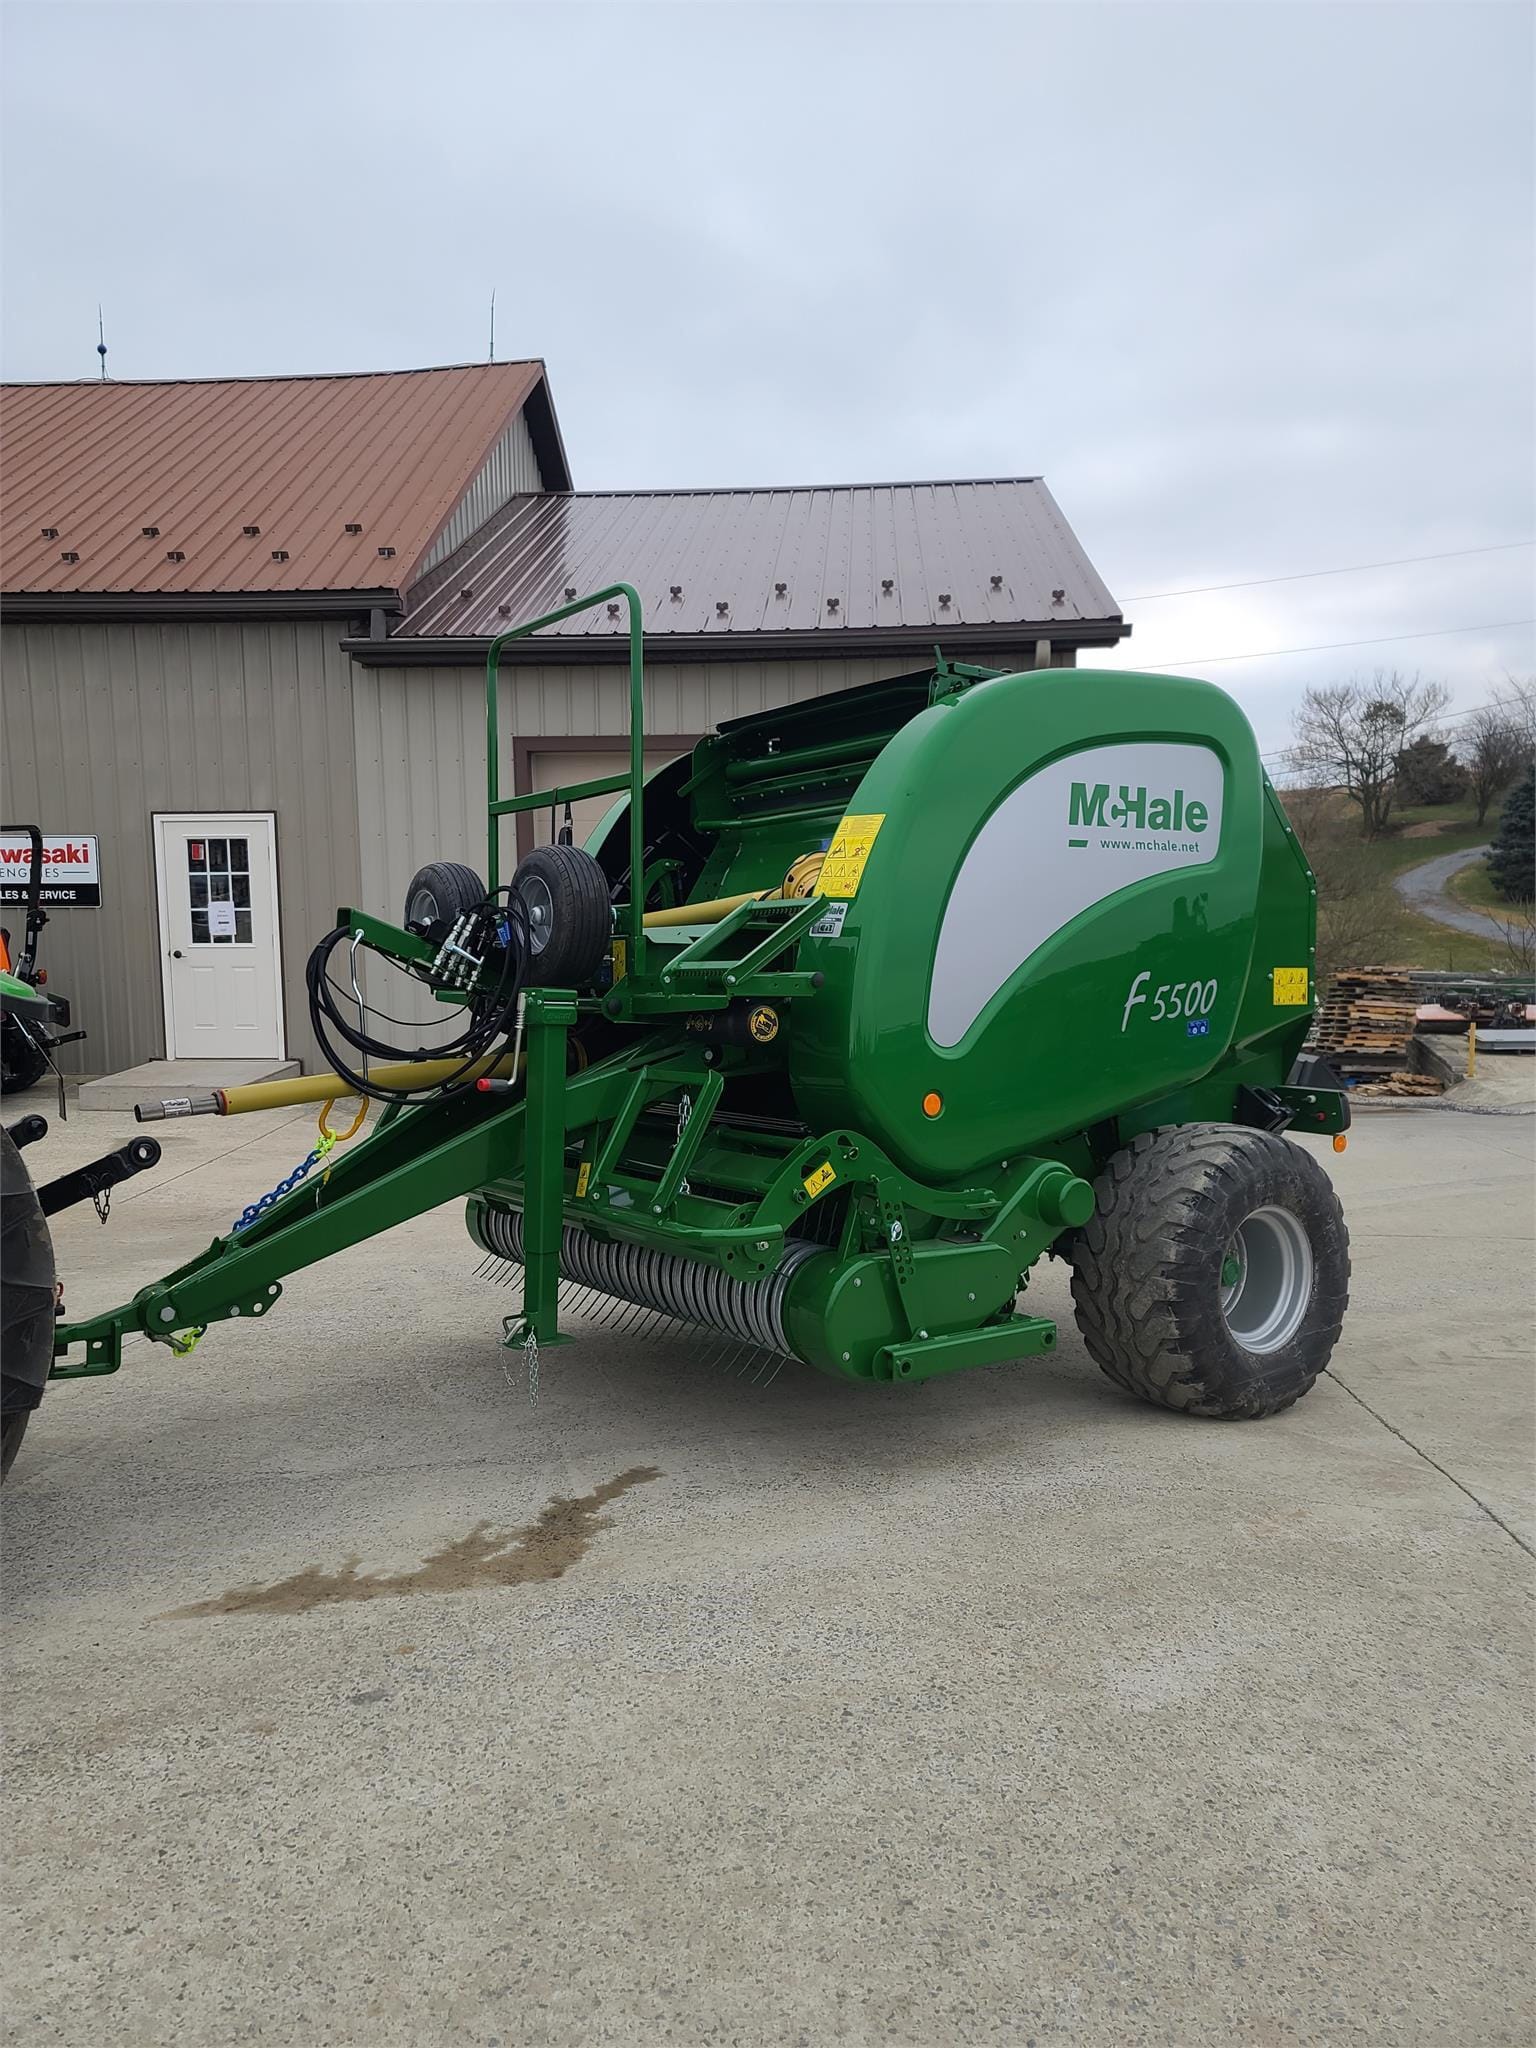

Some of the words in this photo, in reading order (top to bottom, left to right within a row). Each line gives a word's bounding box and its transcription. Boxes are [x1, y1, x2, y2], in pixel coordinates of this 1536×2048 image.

[1069, 782, 1209, 833] McHale
[1100, 840, 1200, 853] www.mchale.net
[0, 843, 89, 864] wasaki
[0, 868, 60, 878] ENGES
[0, 890, 19, 900] LES
[21, 890, 29, 900] &
[40, 890, 77, 900] ERVICE
